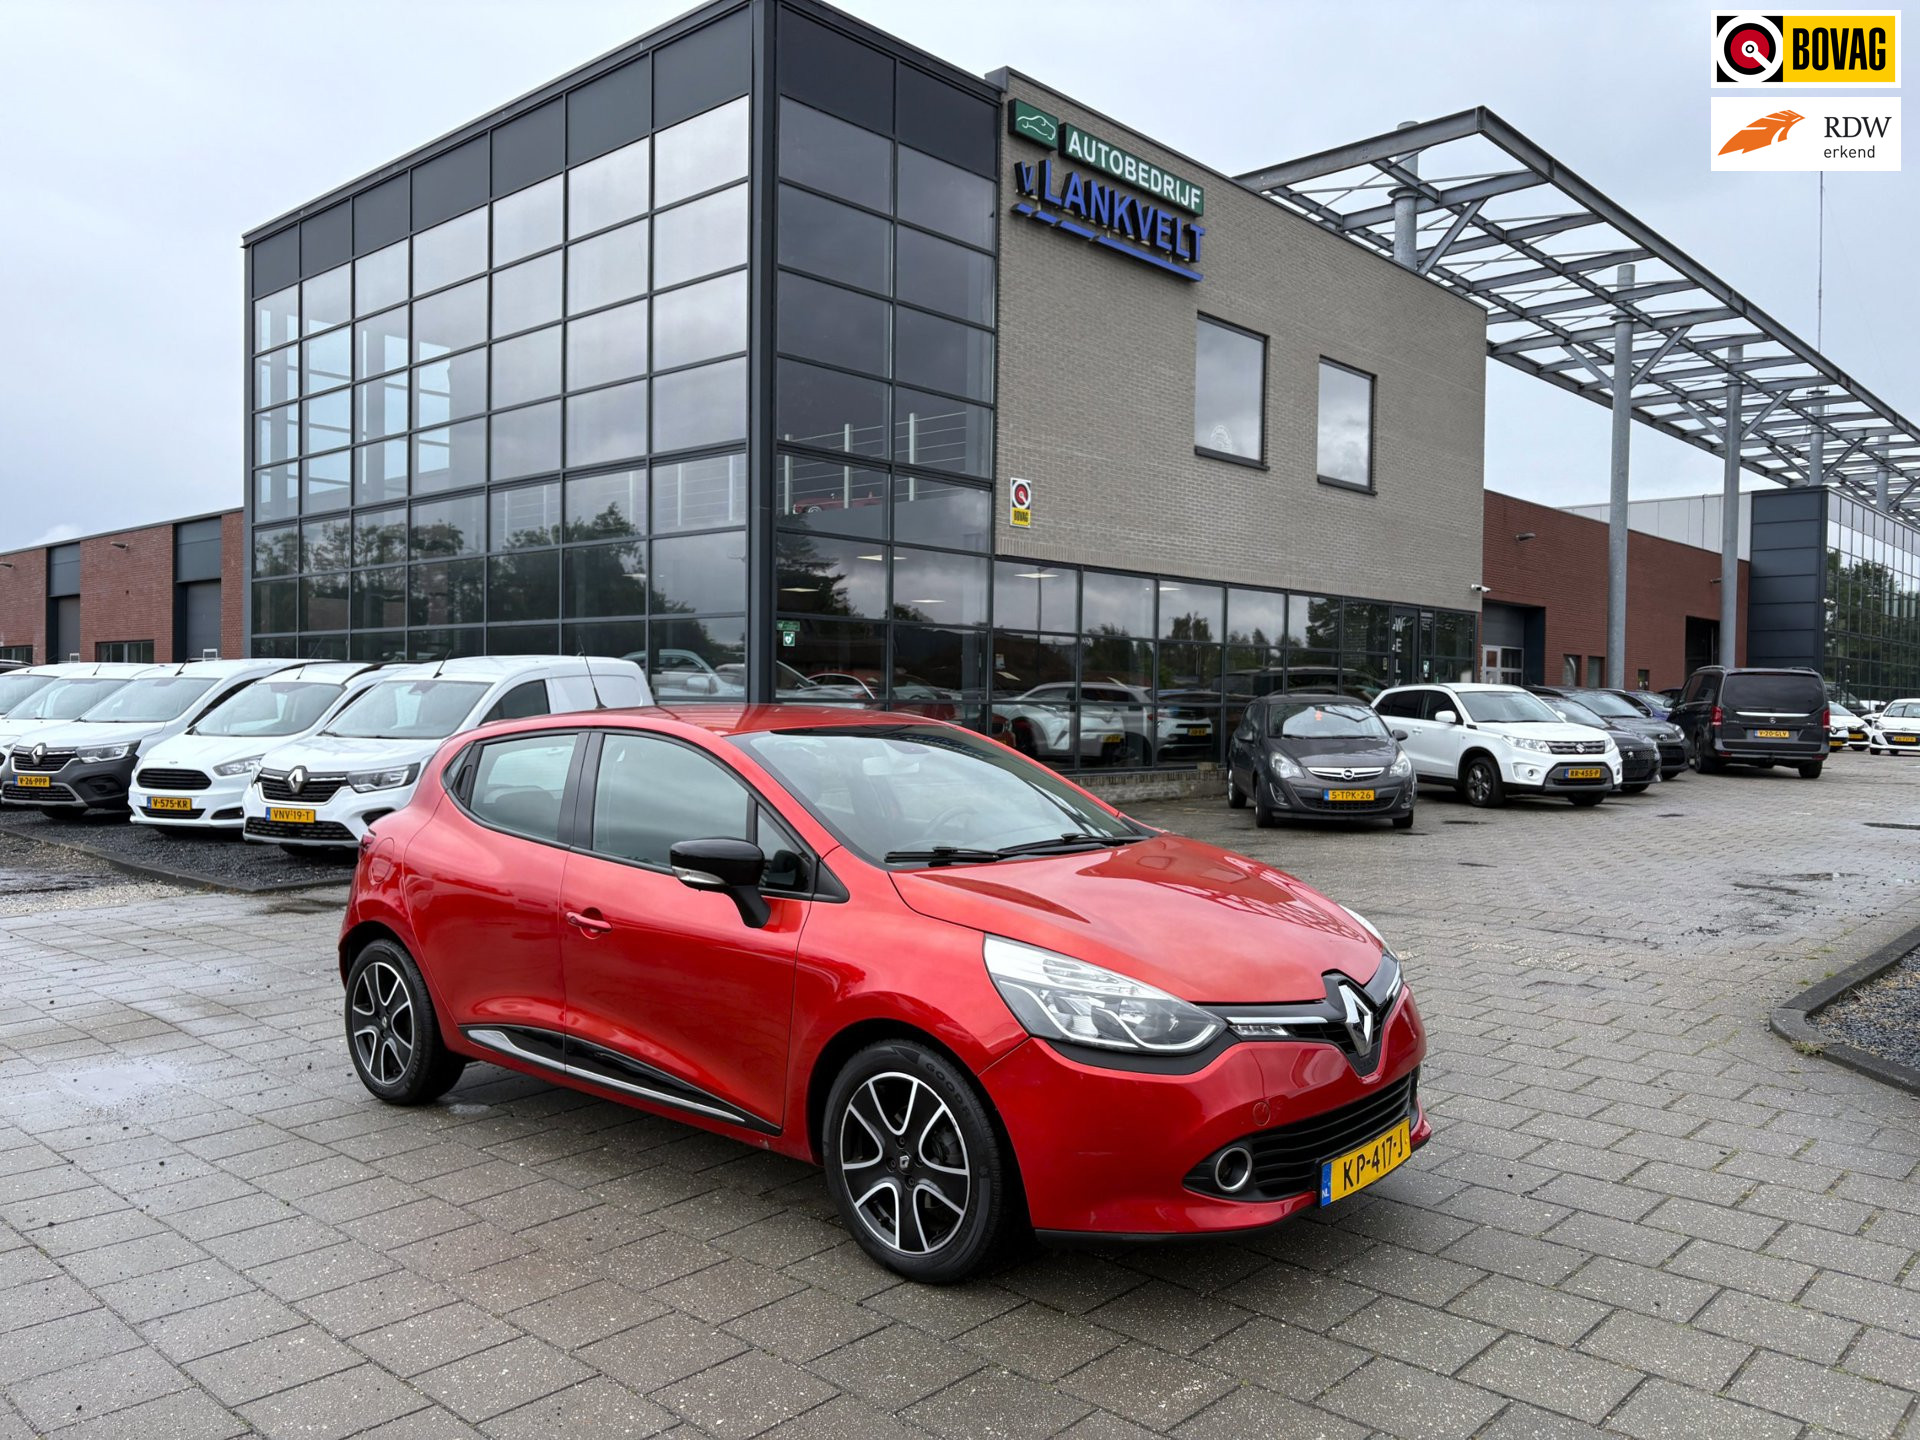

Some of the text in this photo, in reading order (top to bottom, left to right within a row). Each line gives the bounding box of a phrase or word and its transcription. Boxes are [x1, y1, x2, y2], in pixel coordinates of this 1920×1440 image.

[1068, 131, 1201, 210] AUTOBEDRIJF
[1040, 159, 1206, 264] LANKVELT
[1331, 791, 1372, 800] 5-TPK-26
[152, 798, 188, 809] V-575-KR
[273, 809, 312, 821] VNV-19-T
[1343, 1128, 1404, 1191] KP-417-J
[1321, 1187, 1330, 1198] NL
